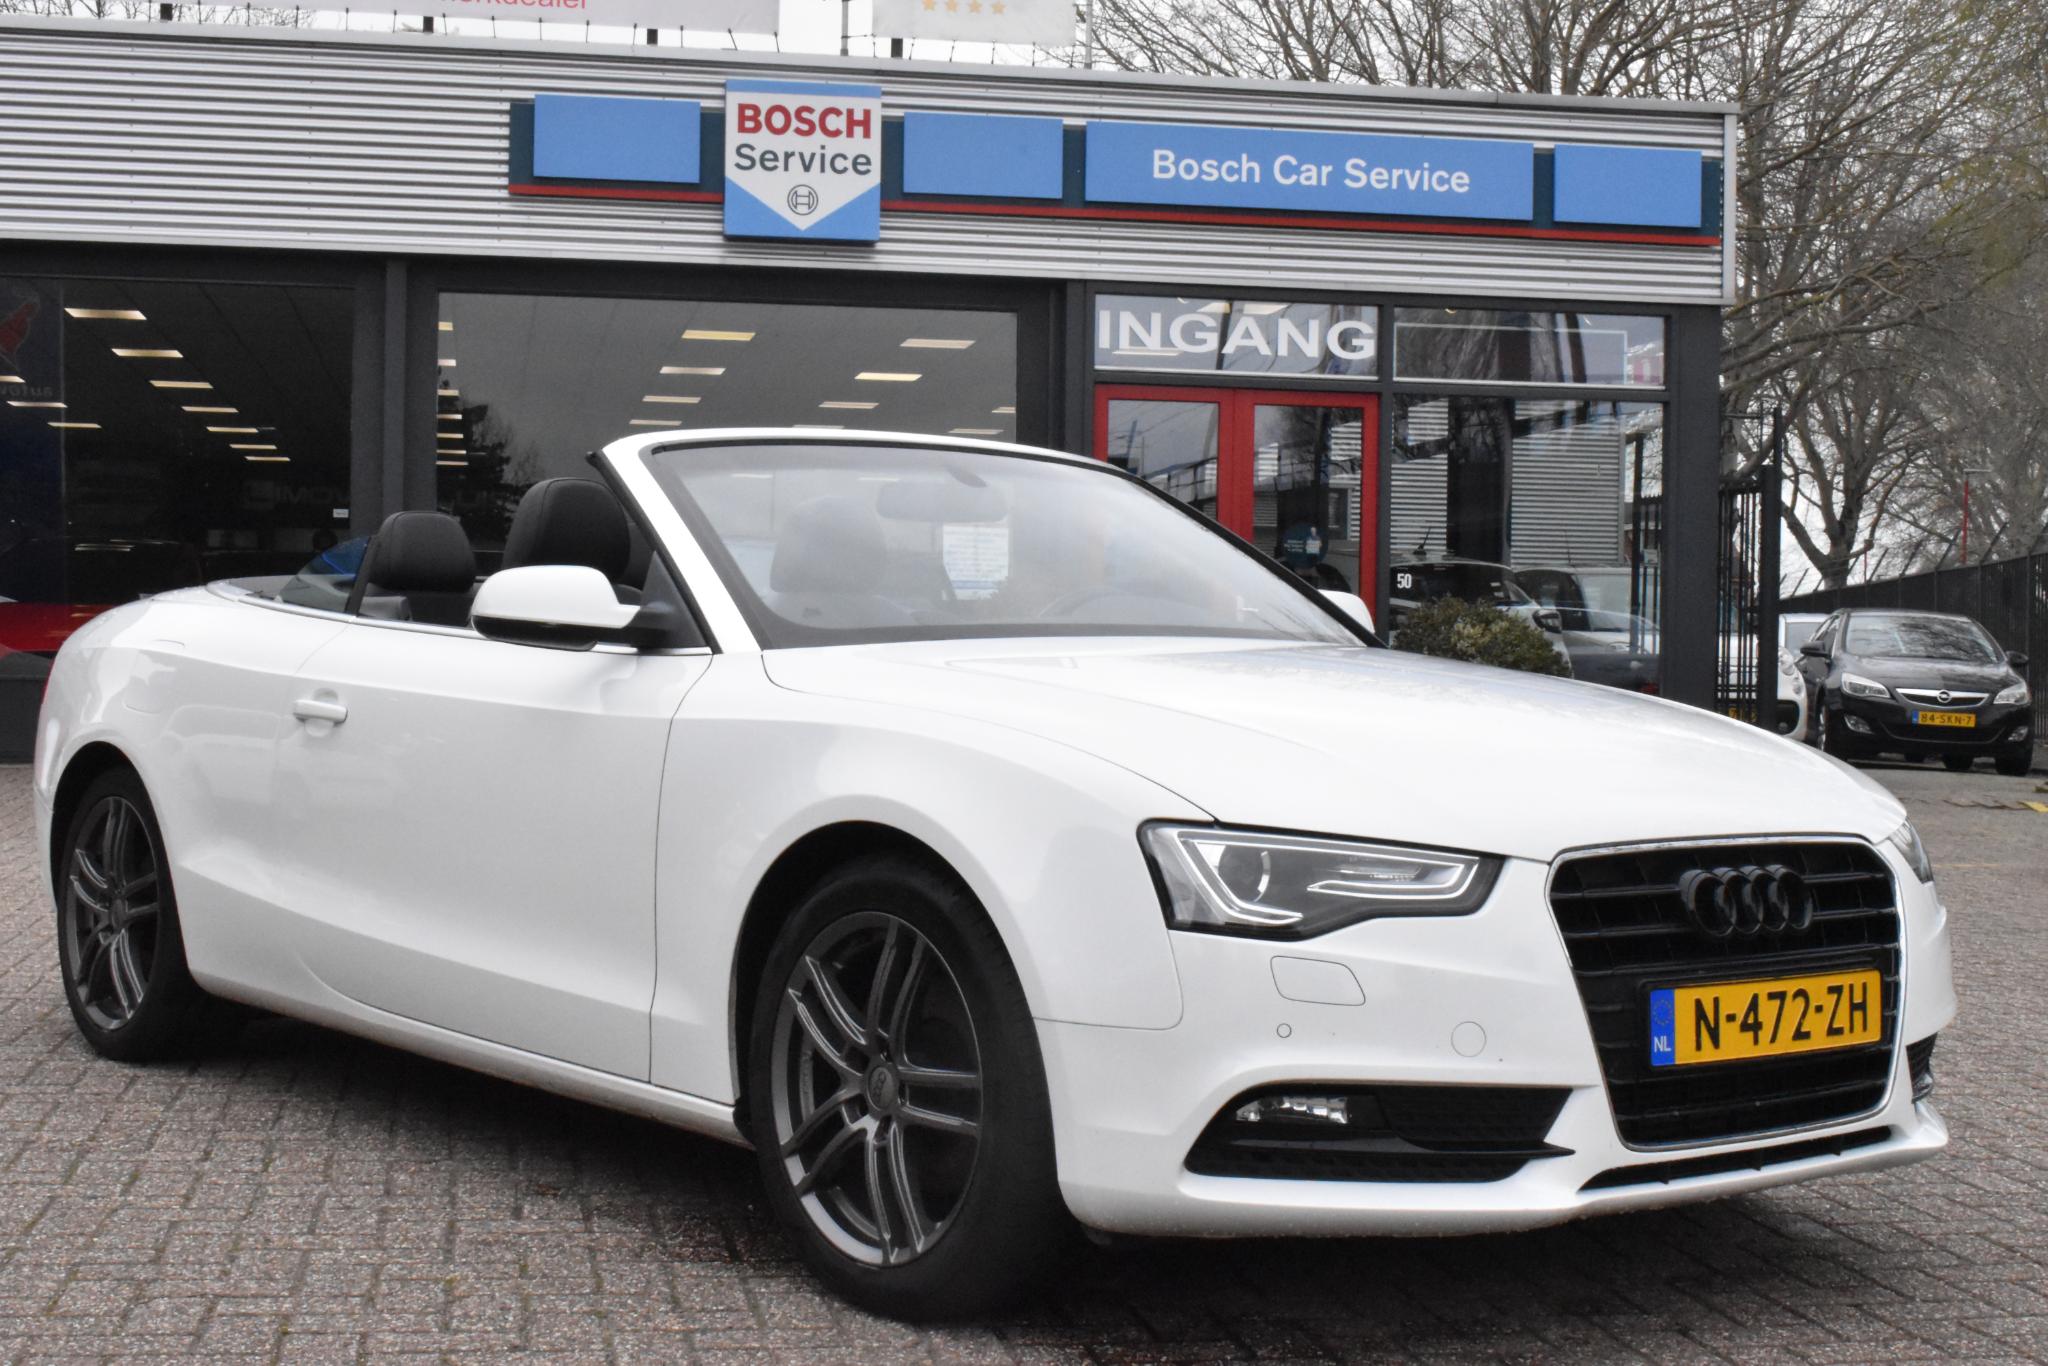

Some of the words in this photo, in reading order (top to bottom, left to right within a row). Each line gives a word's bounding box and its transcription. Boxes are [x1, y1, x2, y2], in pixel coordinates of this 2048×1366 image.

[737, 103, 872, 139] BOSCH
[734, 143, 872, 176] Service
[1152, 149, 1261, 184] Bosch
[1273, 155, 1333, 187] Car
[1344, 158, 1471, 193] Service
[1099, 309, 1376, 361] INGANG
[1396, 573, 1412, 589] 50
[1921, 712, 1972, 726] 84-SKN-7
[1653, 1035, 1672, 1053] NL
[1694, 981, 1868, 1052] N-472-ZH
